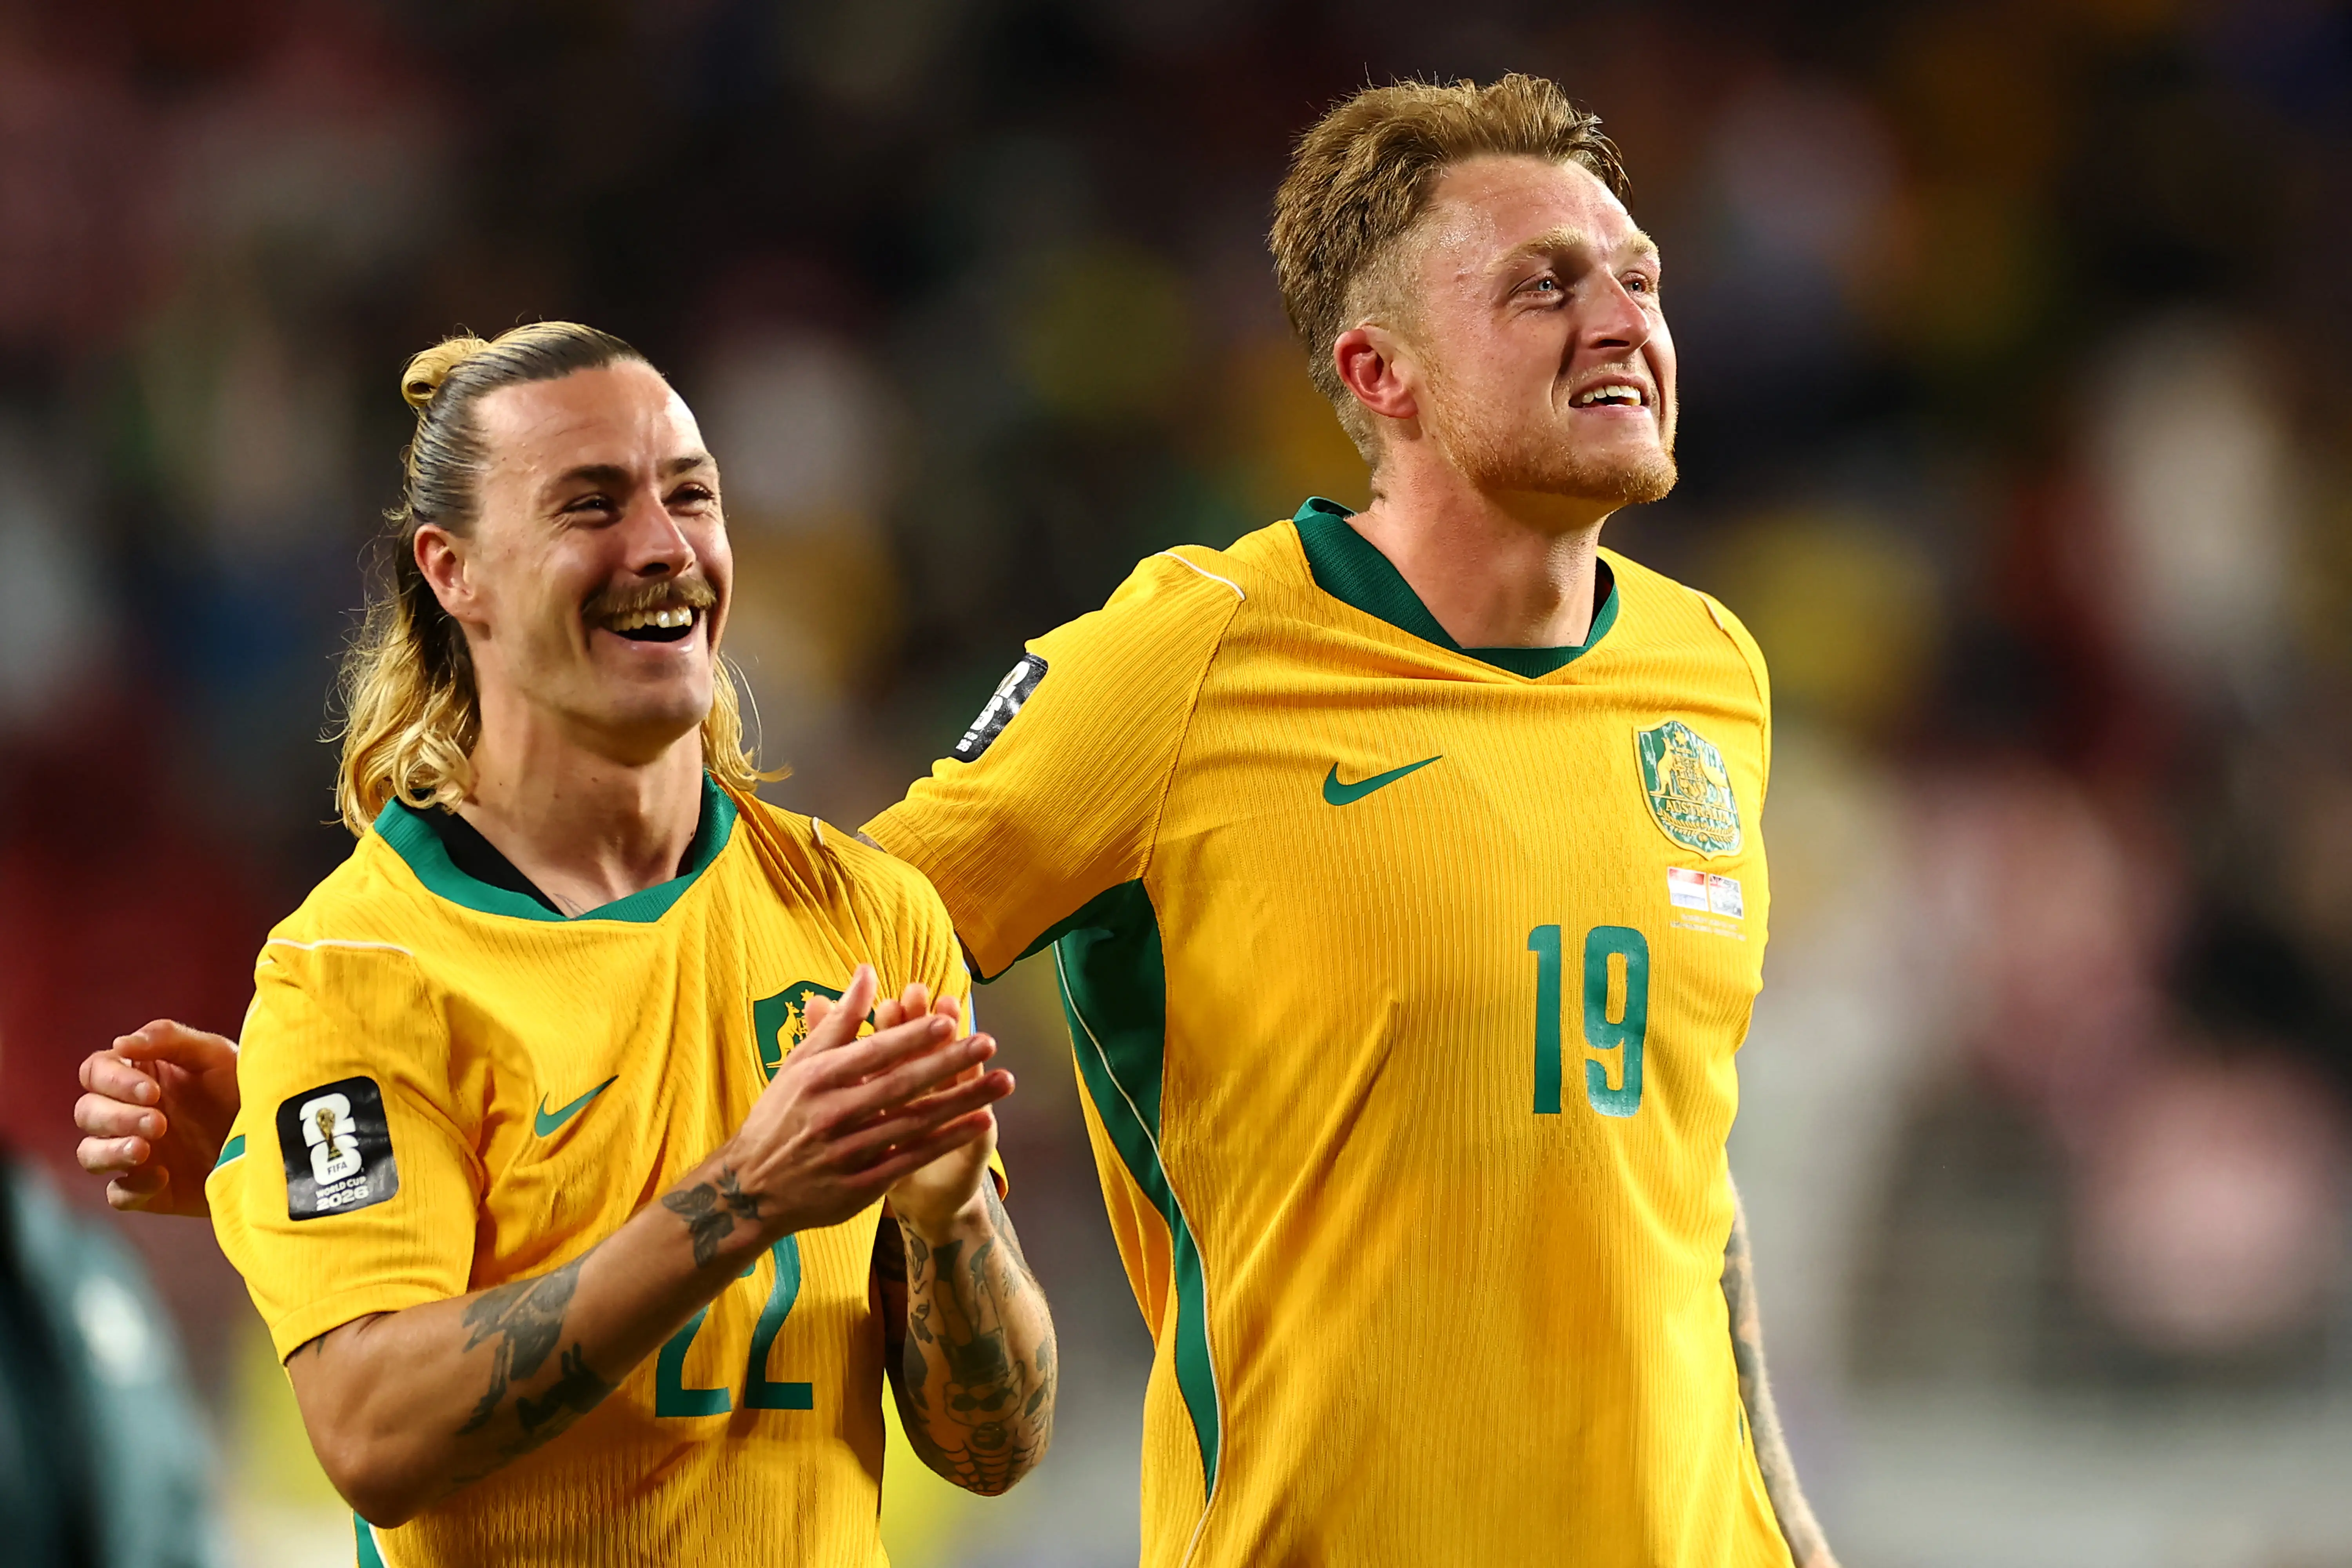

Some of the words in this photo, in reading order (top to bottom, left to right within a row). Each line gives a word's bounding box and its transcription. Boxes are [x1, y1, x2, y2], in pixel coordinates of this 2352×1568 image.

[1528, 924, 1649, 1118] 19
[327, 1161, 348, 1175] FIFA
[316, 1181, 345, 1198] WORLD
[347, 1176, 367, 1187] CUP
[316, 1185, 369, 1211] 2026
